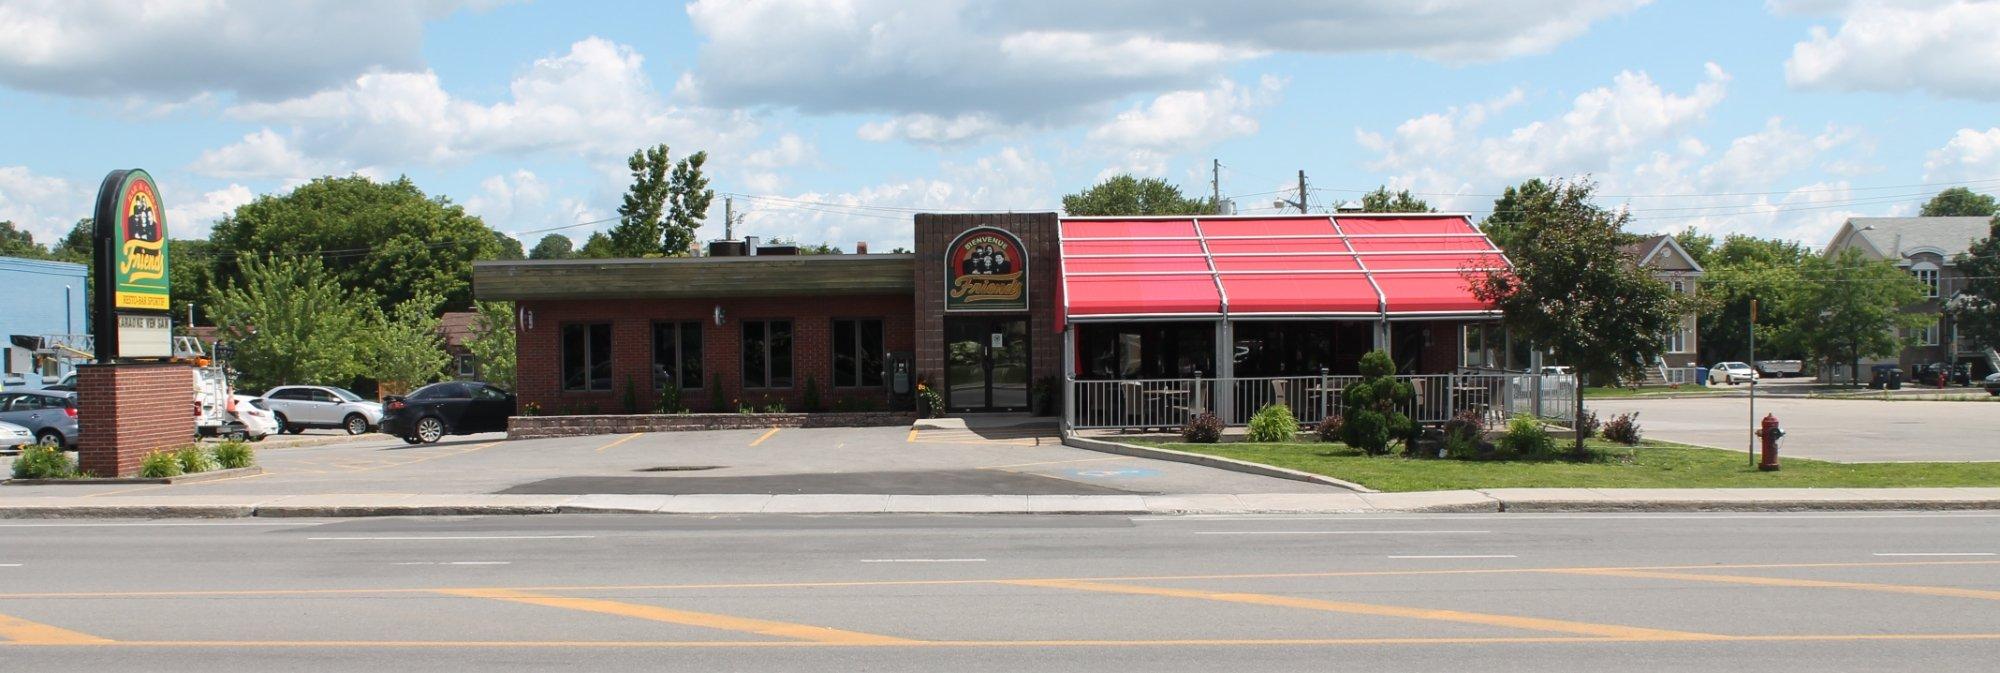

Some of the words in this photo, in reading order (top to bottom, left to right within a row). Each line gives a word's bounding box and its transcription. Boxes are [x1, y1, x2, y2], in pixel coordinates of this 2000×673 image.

[964, 236, 1008, 250] BIENVENUE
[120, 237, 164, 283] Friends
[950, 270, 1023, 303] Friends
